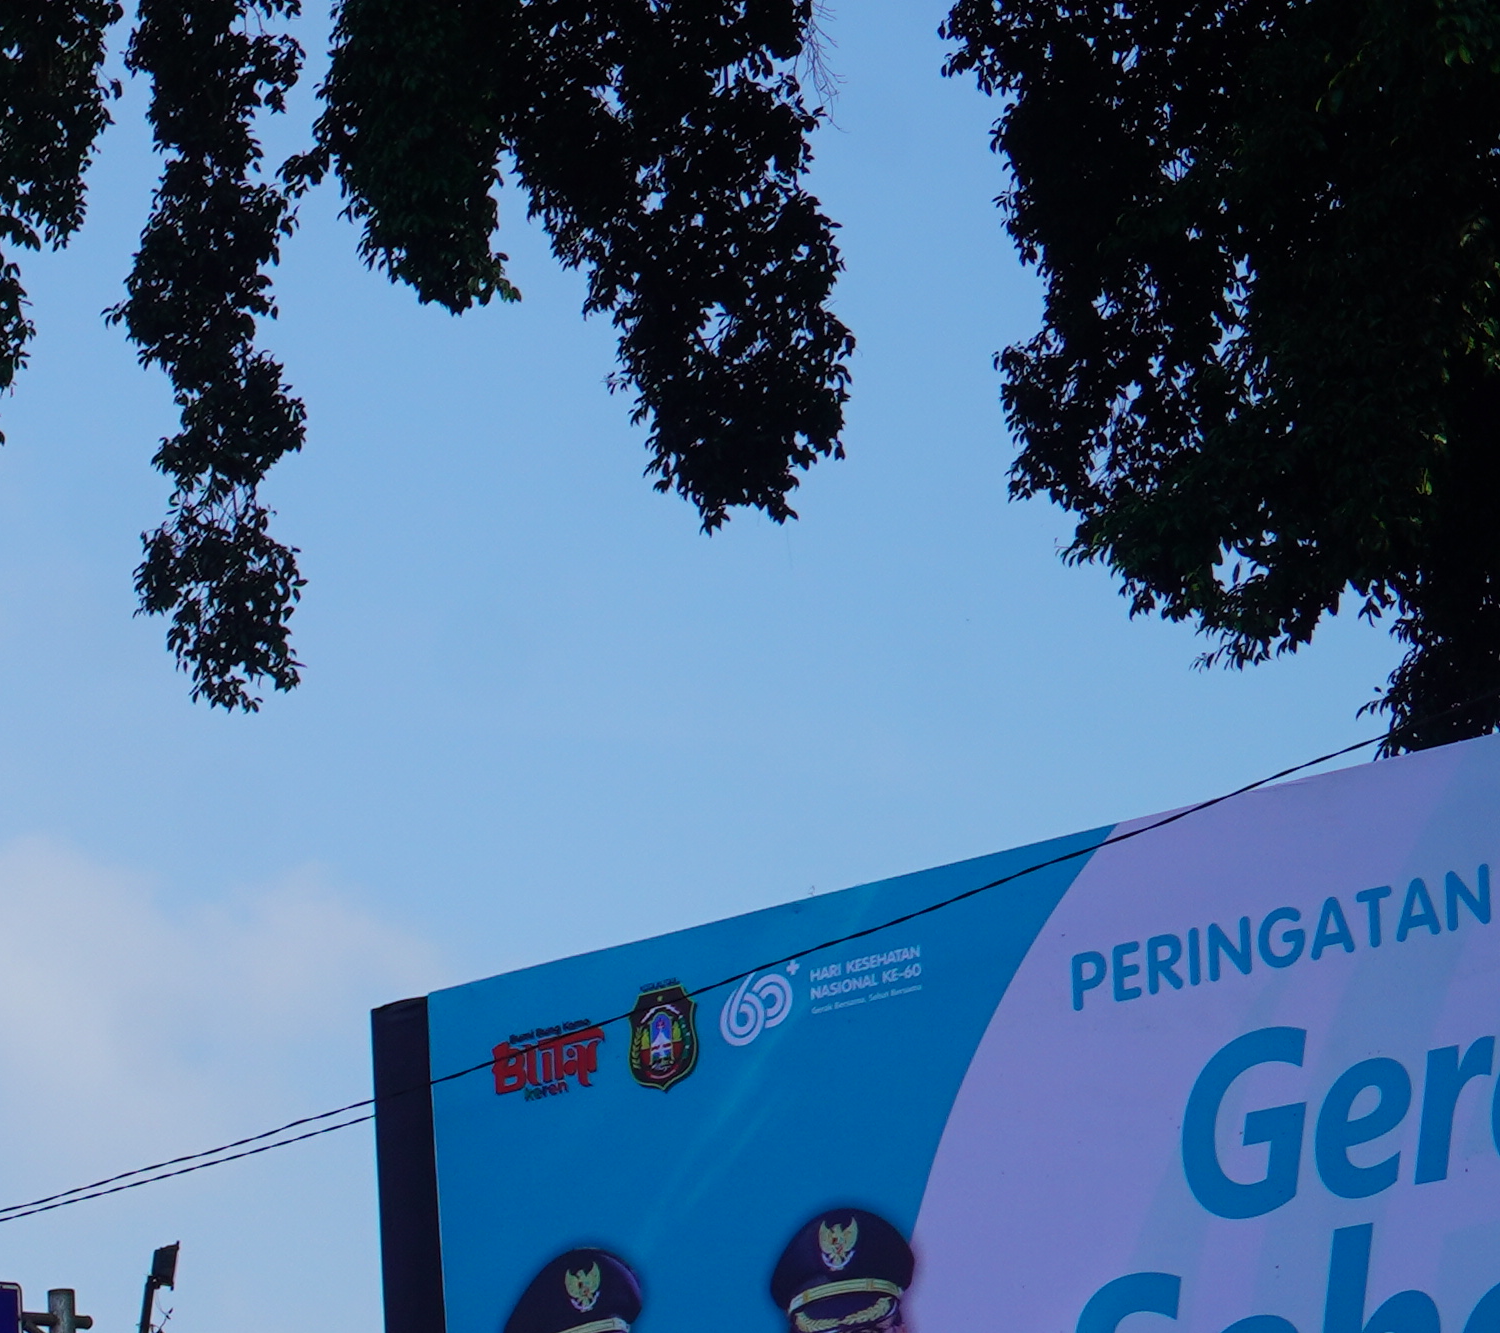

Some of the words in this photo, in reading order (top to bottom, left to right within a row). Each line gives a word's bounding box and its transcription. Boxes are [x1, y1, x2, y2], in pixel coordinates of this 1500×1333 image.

[810, 963, 841, 982] HARI
[845, 945, 921, 973] KESEHATAN
[1071, 863, 1492, 1012] PERINGATAN
[810, 975, 878, 1000] NASIONAL
[1182, 1026, 1500, 1221] Ger
